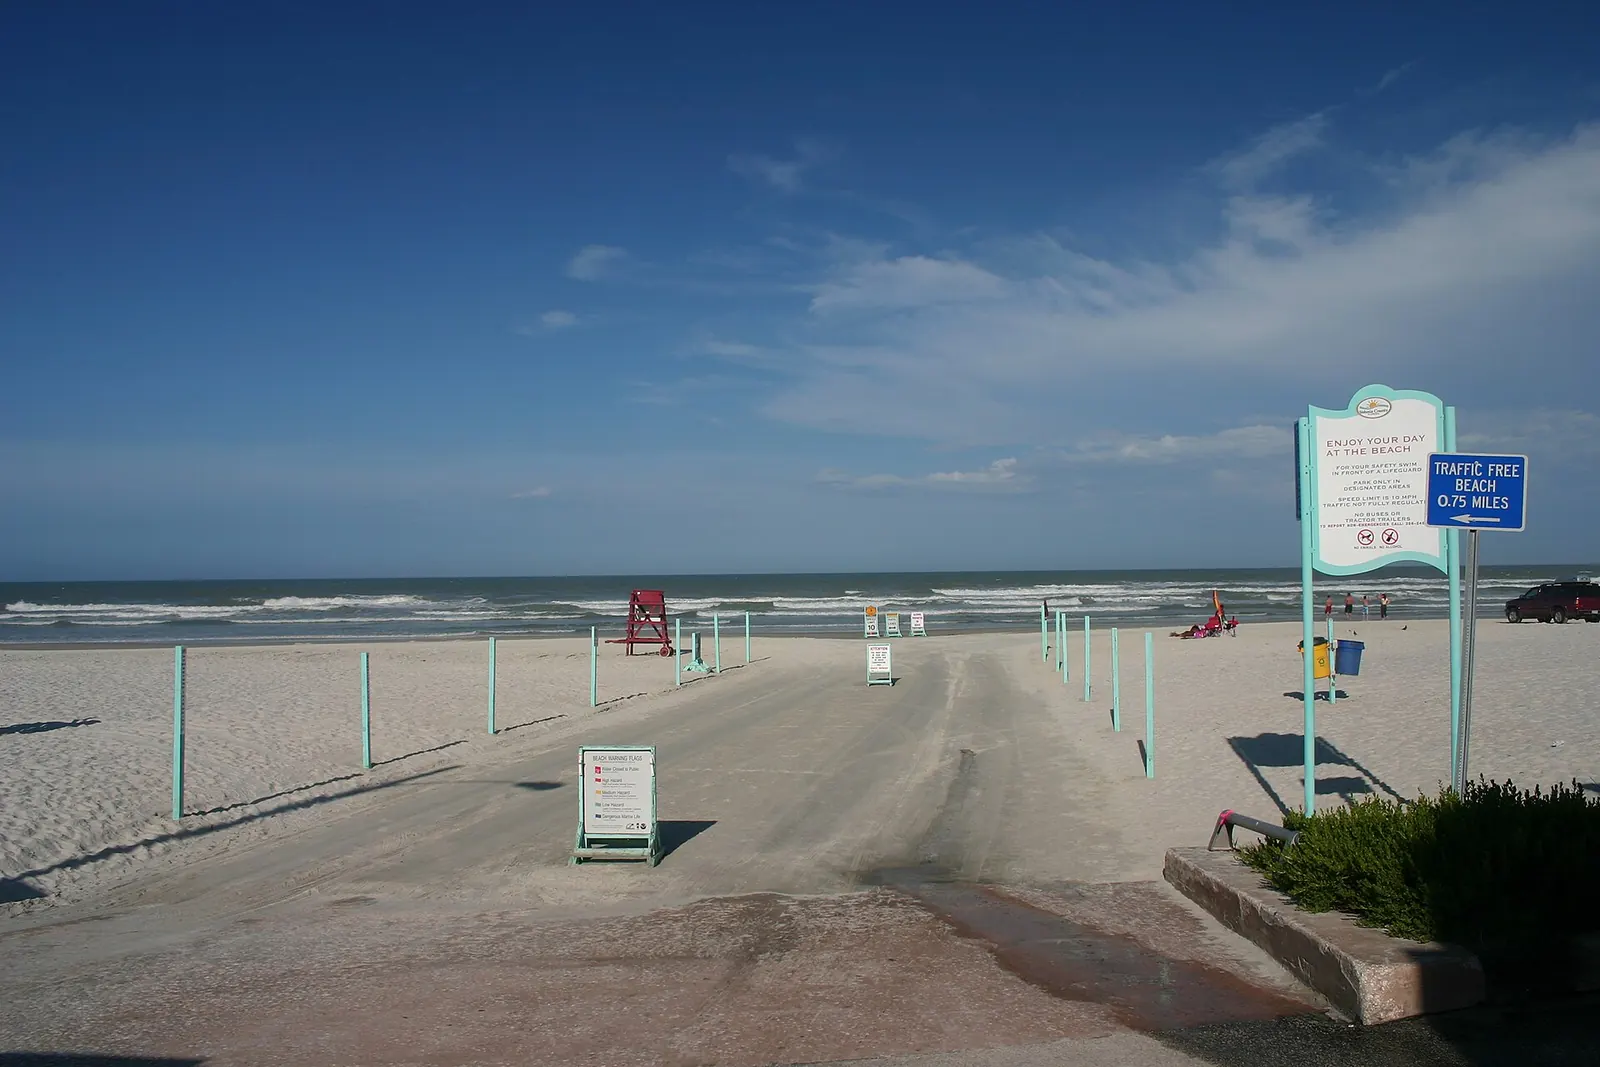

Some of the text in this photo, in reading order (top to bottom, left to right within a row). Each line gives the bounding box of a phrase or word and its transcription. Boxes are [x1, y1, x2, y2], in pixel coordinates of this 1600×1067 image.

[1326, 439, 1363, 447] ENJOY
[1372, 446, 1411, 454] BEACH
[1434, 462, 1519, 477] TRAFFIC FREE
[1456, 479, 1496, 492] BEACH
[1437, 495, 1509, 509] 0.75 MILES
